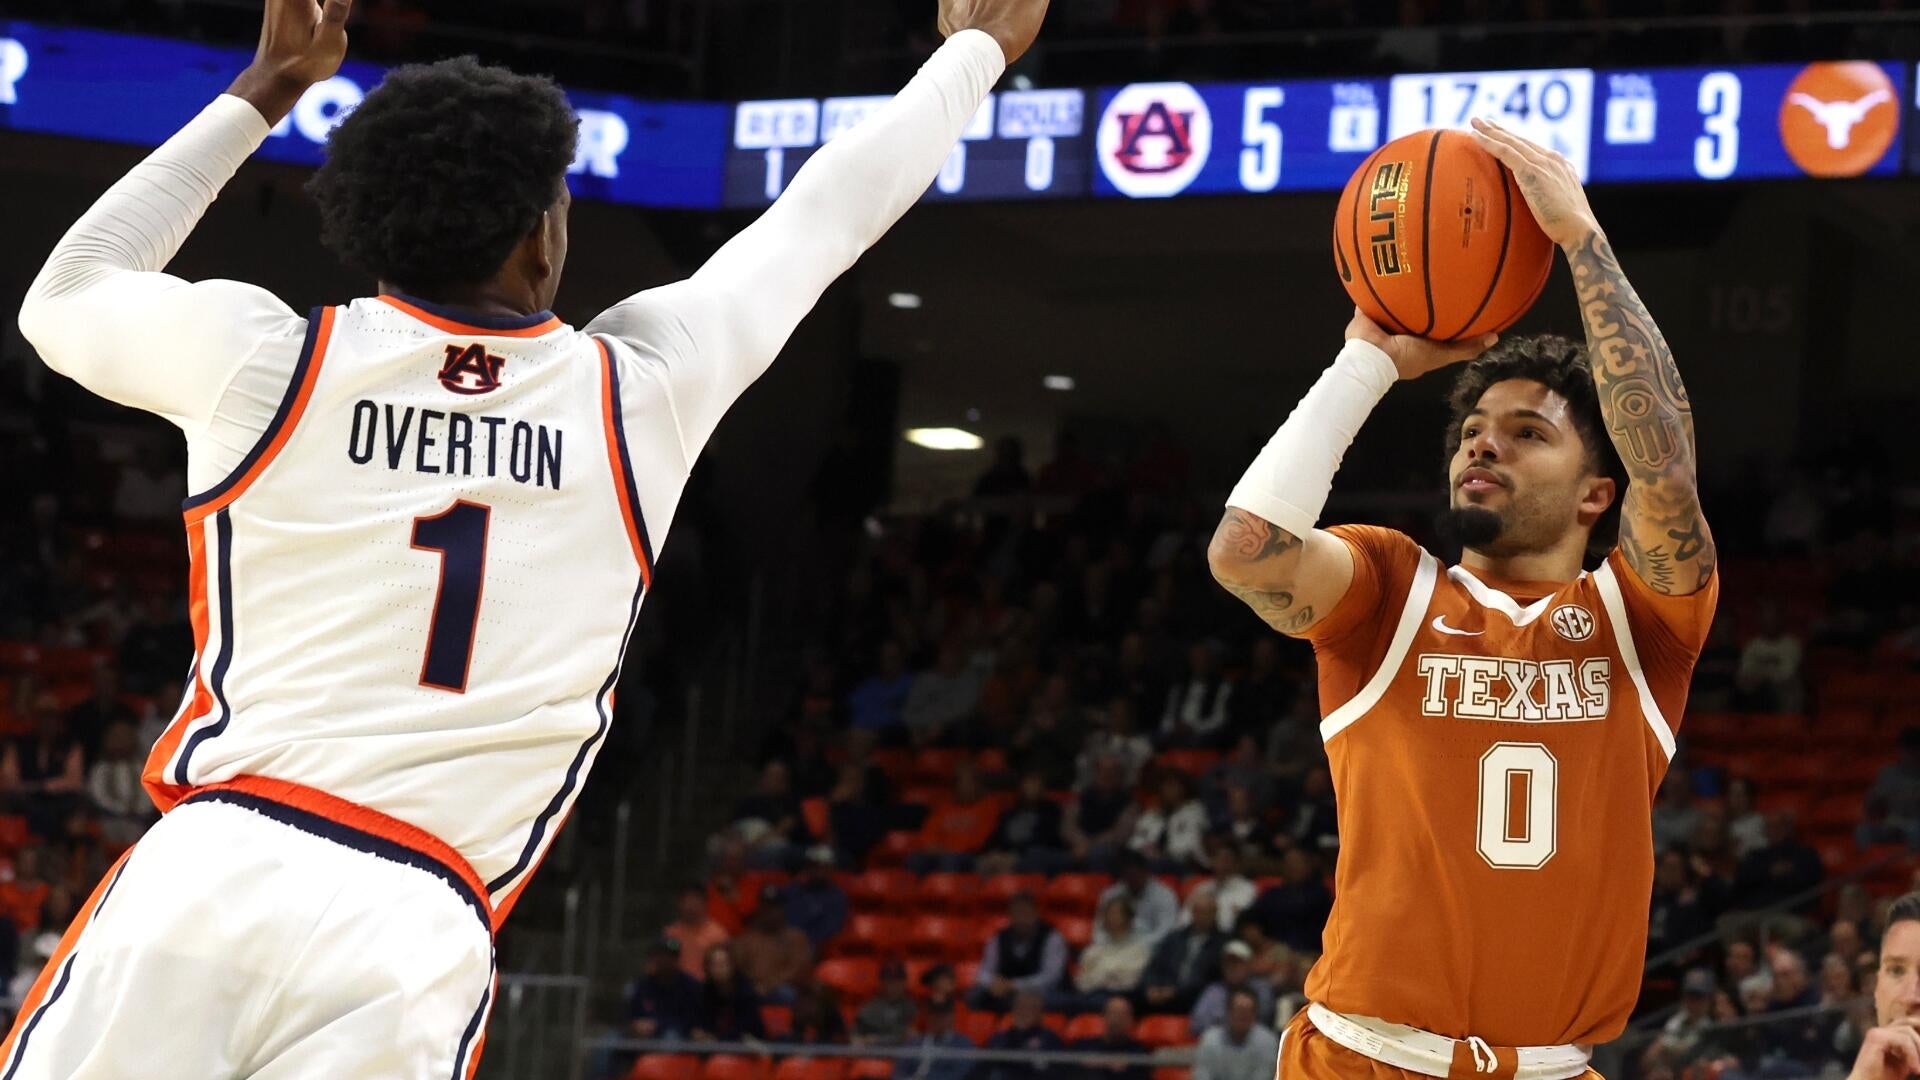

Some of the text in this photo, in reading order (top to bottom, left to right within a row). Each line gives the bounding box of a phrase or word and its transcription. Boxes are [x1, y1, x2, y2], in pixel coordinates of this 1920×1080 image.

[1238, 87, 1284, 191] 5
[1422, 79, 1573, 125] 17:40
[1694, 71, 1743, 179] 3
[765, 147, 784, 199] 1
[1024, 136, 1055, 191] 0
[1369, 159, 1404, 277] ELITE
[348, 399, 563, 490] OVERTON
[410, 499, 491, 694] 1
[1551, 606, 1593, 639] SEC
[1417, 654, 1610, 723] TEXAS
[1476, 741, 1558, 870] 0
